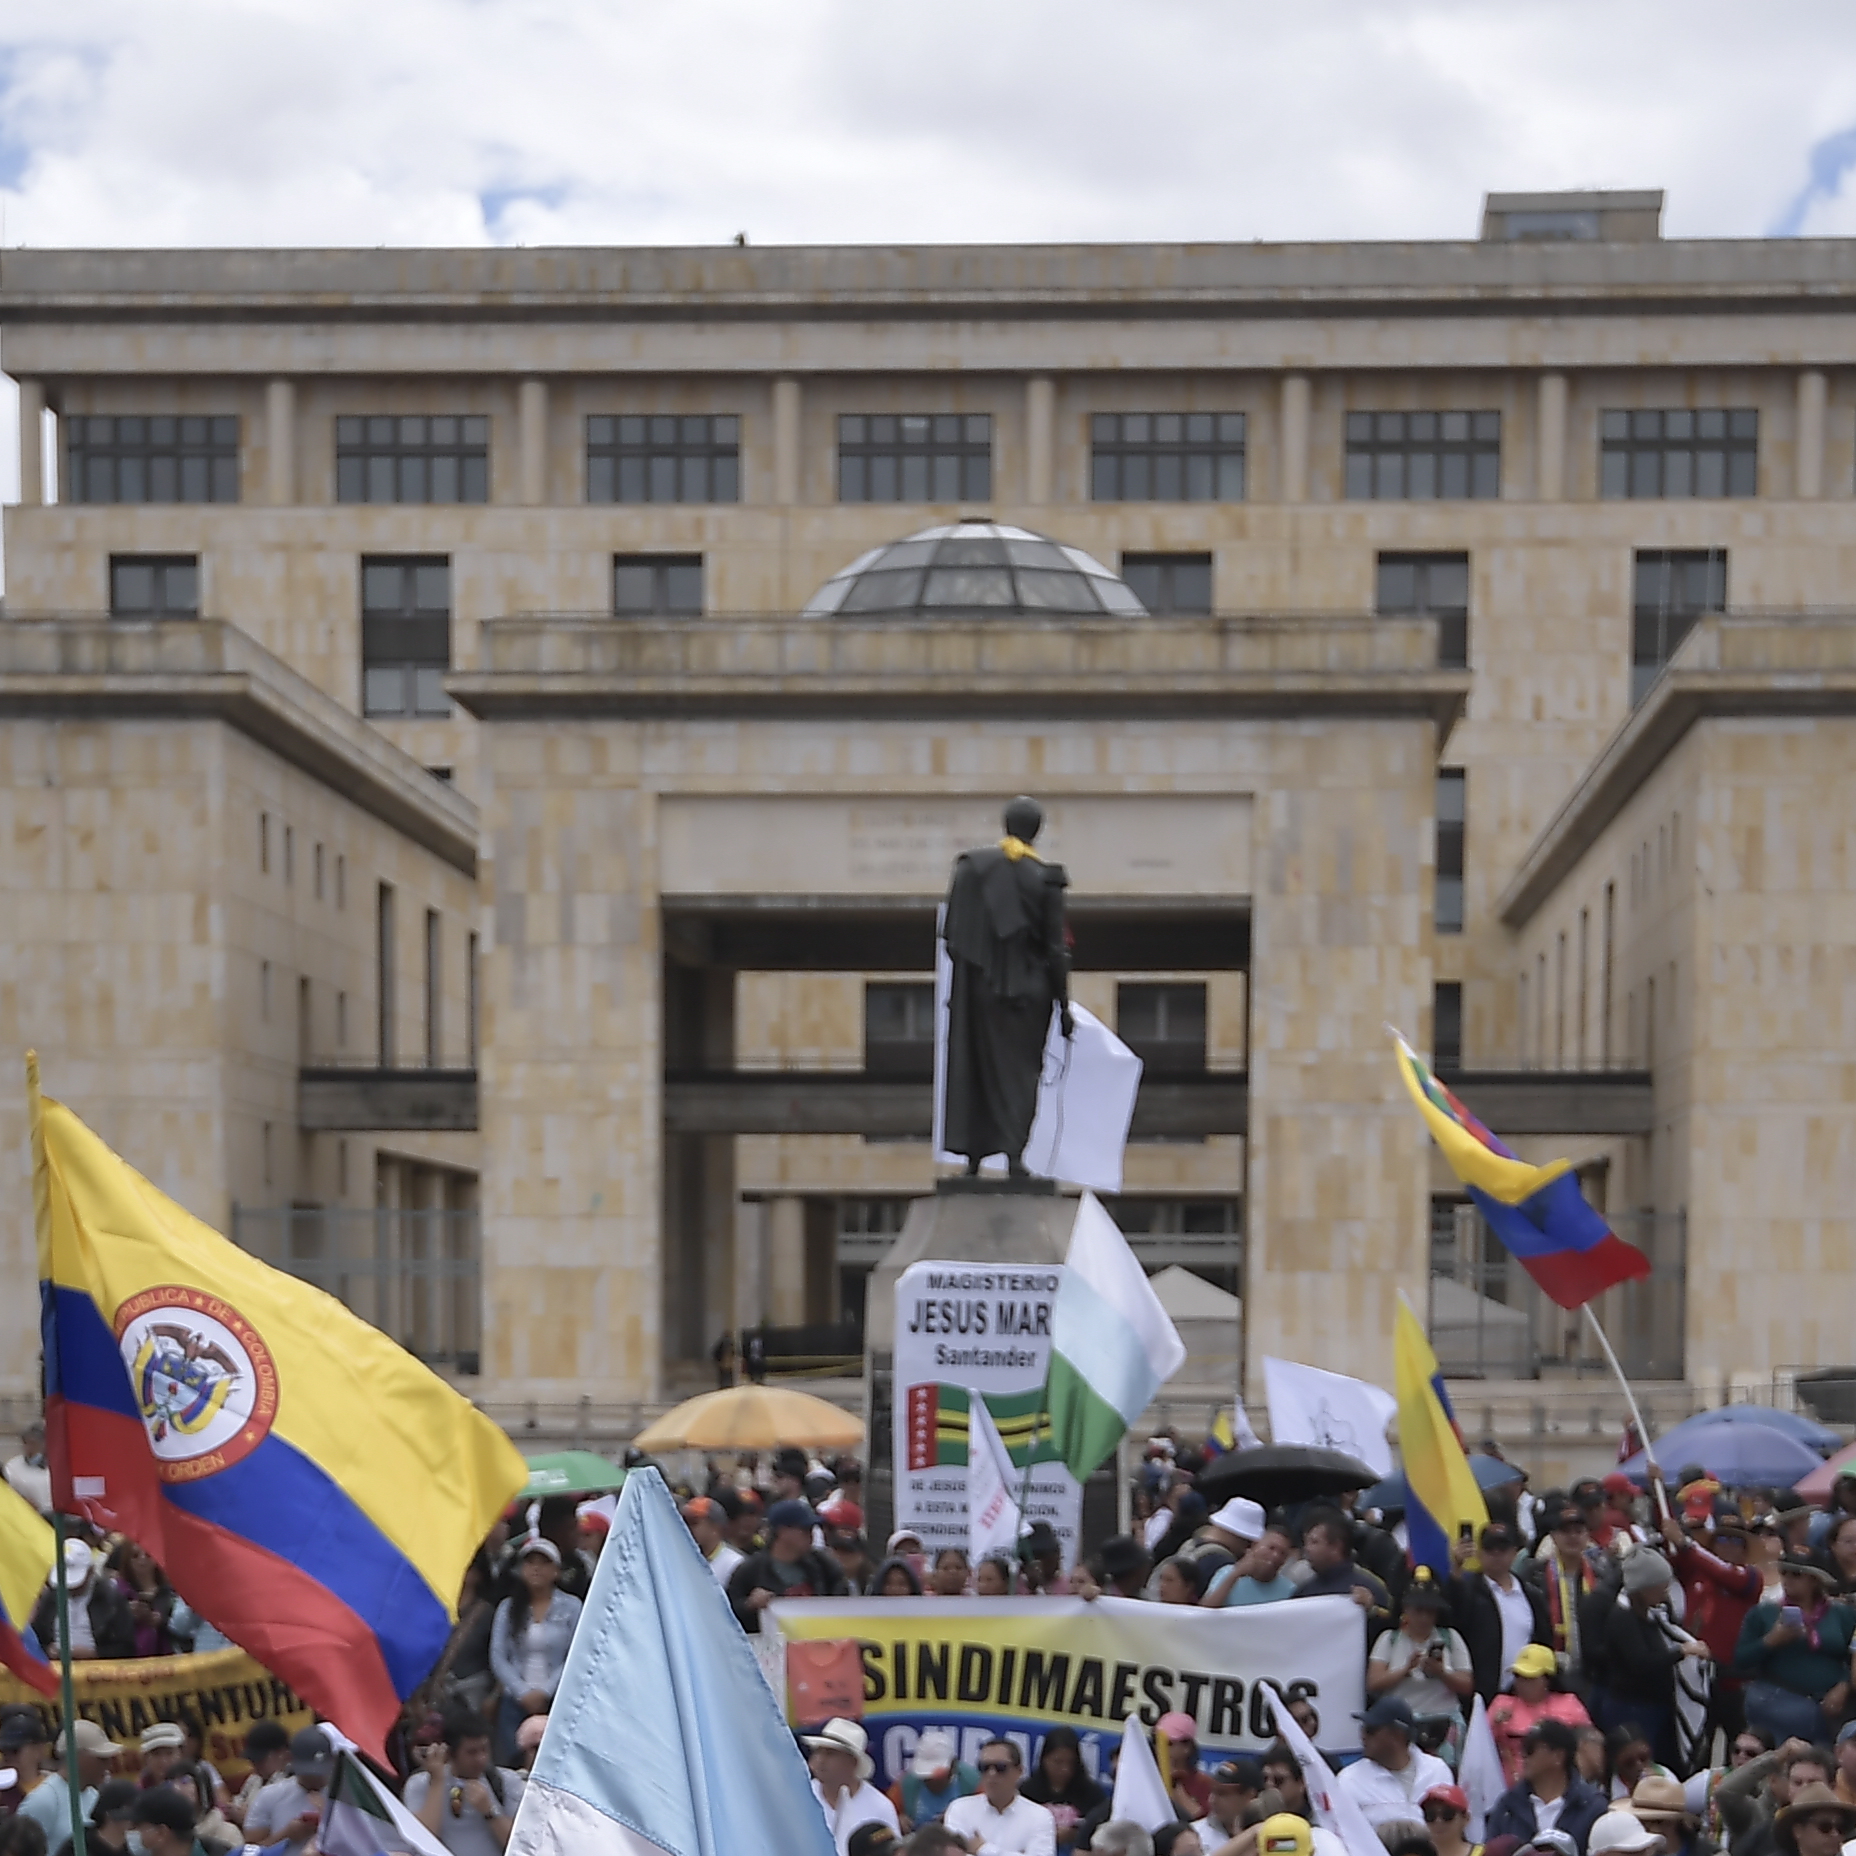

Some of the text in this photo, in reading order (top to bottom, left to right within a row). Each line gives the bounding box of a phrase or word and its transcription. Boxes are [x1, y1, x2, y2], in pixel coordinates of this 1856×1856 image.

[928, 1274, 1060, 1292] MAGISTERIO
[909, 1300, 1052, 1335] JESUS MAR
[208, 1301, 232, 1321] DE
[243, 1330, 275, 1415] COLOMBIA
[935, 1344, 1036, 1367] Santander
[168, 1451, 226, 1479] ORDEN
[858, 1639, 1319, 1740] SINDIMAESTROS
